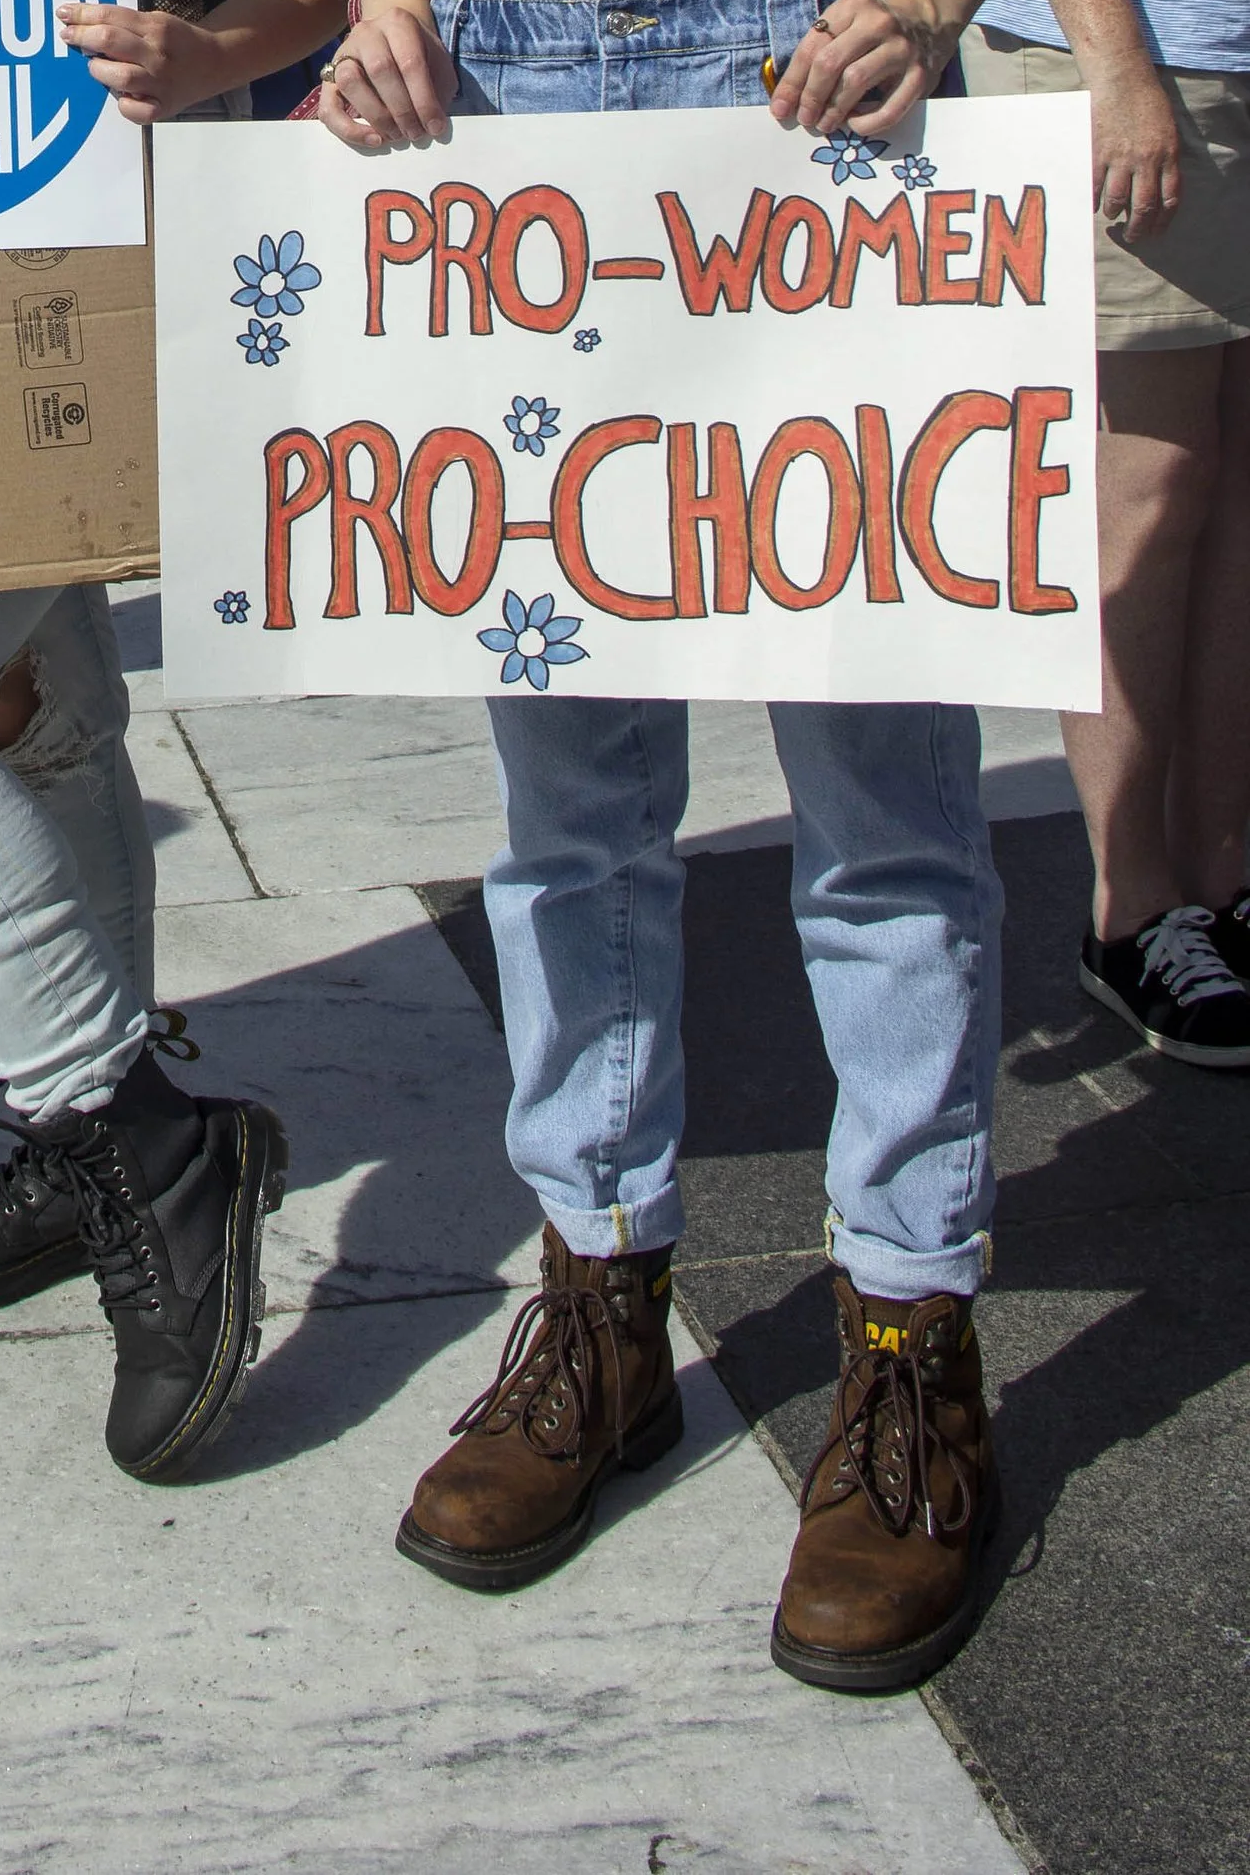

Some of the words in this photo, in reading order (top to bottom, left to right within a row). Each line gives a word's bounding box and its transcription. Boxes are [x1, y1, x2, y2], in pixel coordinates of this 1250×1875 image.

[363, 181, 1046, 338] PRO-WOMEN
[42, 397, 53, 437] Recycles
[51, 392, 65, 440] Corrugated
[263, 386, 1078, 630] PRO-CHOICE
[866, 1321, 908, 1357] CA
